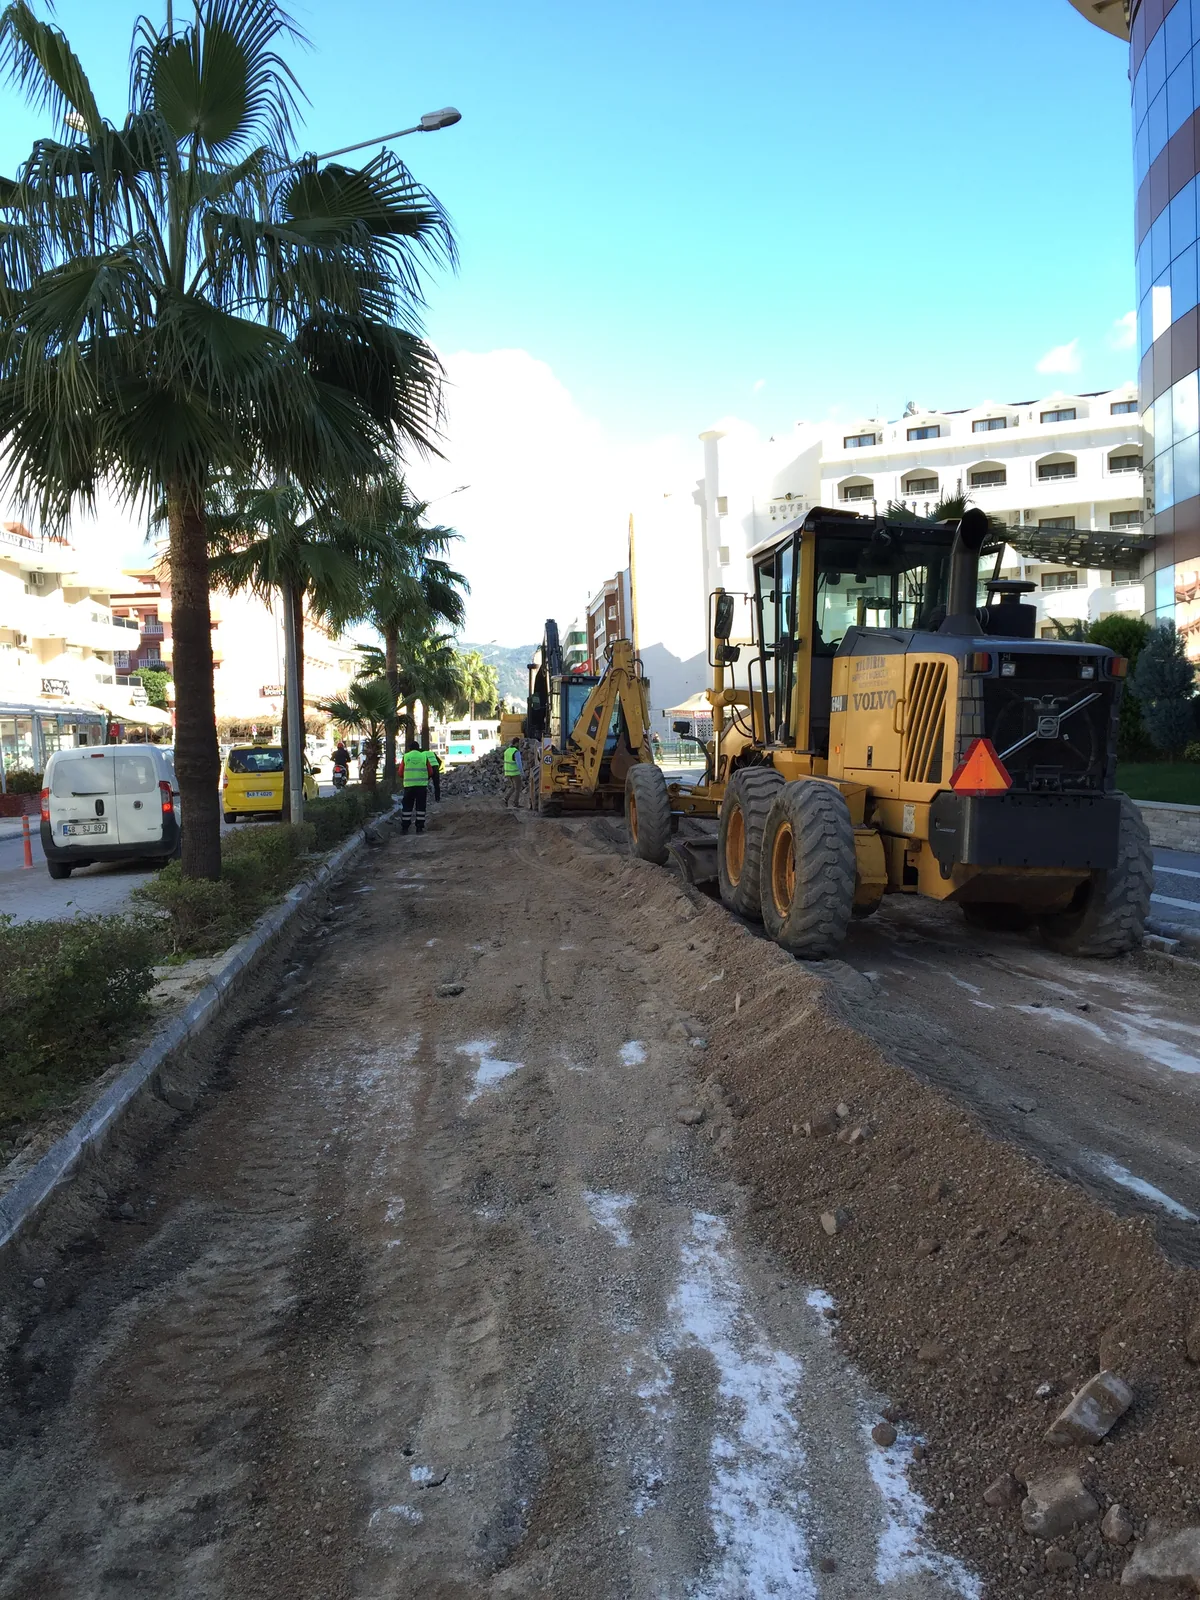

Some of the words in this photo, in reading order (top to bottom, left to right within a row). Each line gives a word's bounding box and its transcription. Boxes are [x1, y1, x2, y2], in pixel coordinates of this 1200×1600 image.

[769, 502, 811, 514] HOTEL
[852, 689, 897, 711] VOLVO
[94, 824, 105, 832] 897
